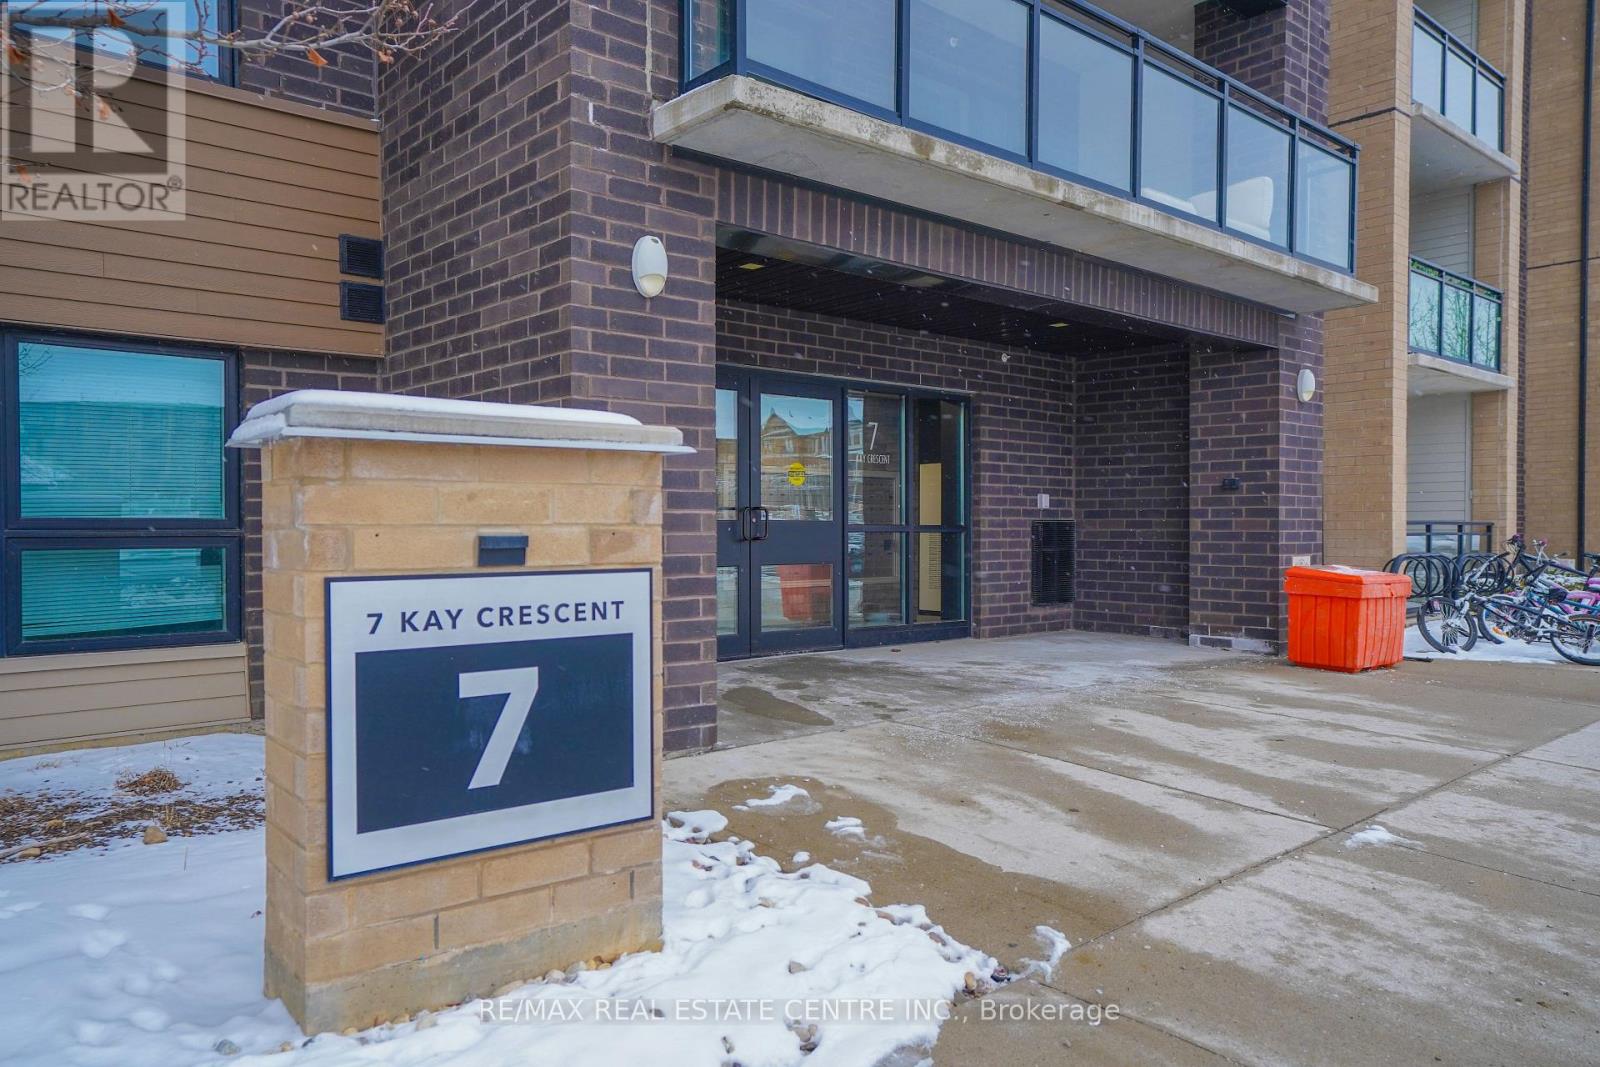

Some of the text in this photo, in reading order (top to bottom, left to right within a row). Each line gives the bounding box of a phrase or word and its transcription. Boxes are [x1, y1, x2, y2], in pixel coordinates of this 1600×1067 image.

[867, 422, 879, 450] 7
[867, 454, 890, 464] CRESCENT
[367, 601, 624, 634] 7 KAY CRESCENT
[459, 666, 539, 790] 7
